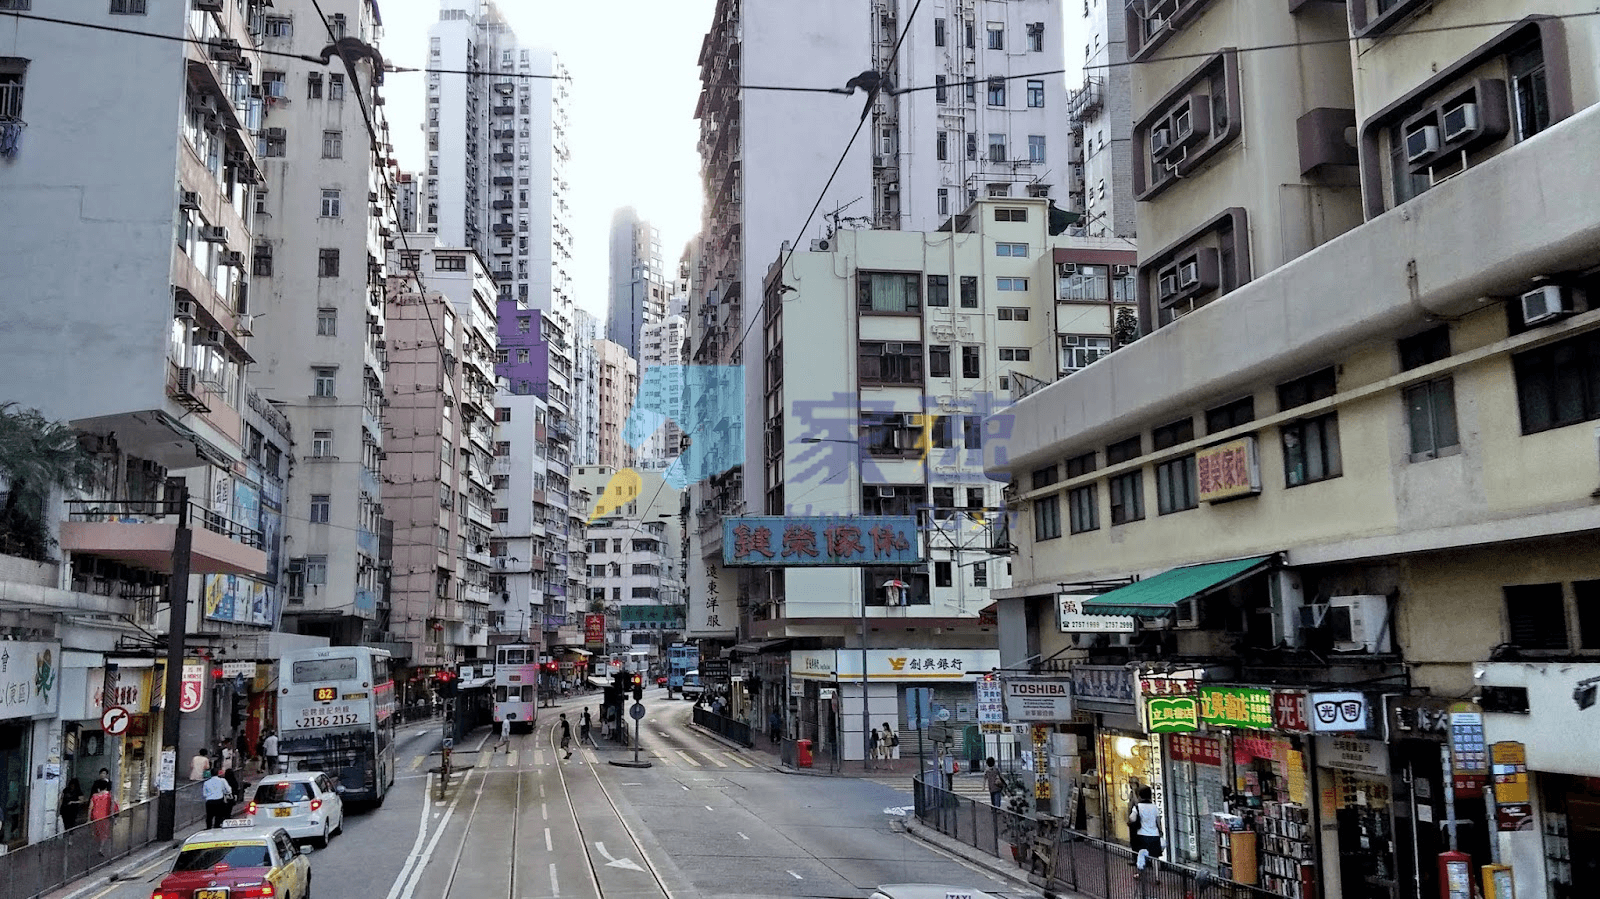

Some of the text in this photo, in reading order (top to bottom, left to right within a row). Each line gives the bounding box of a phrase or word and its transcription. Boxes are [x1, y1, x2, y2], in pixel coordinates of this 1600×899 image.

[732, 522, 910, 558] 鍵榮傢俬
[706, 564, 722, 627] 遠東洋服
[1061, 601, 1078, 615] 萬
[909, 657, 963, 671] 創興銀行
[318, 688, 333, 700] 82
[1011, 683, 1066, 695] TOSHIBA
[1321, 703, 1357, 718] 光明
[303, 713, 358, 728] 2136 2152
[225, 820, 252, 828] TAXI
